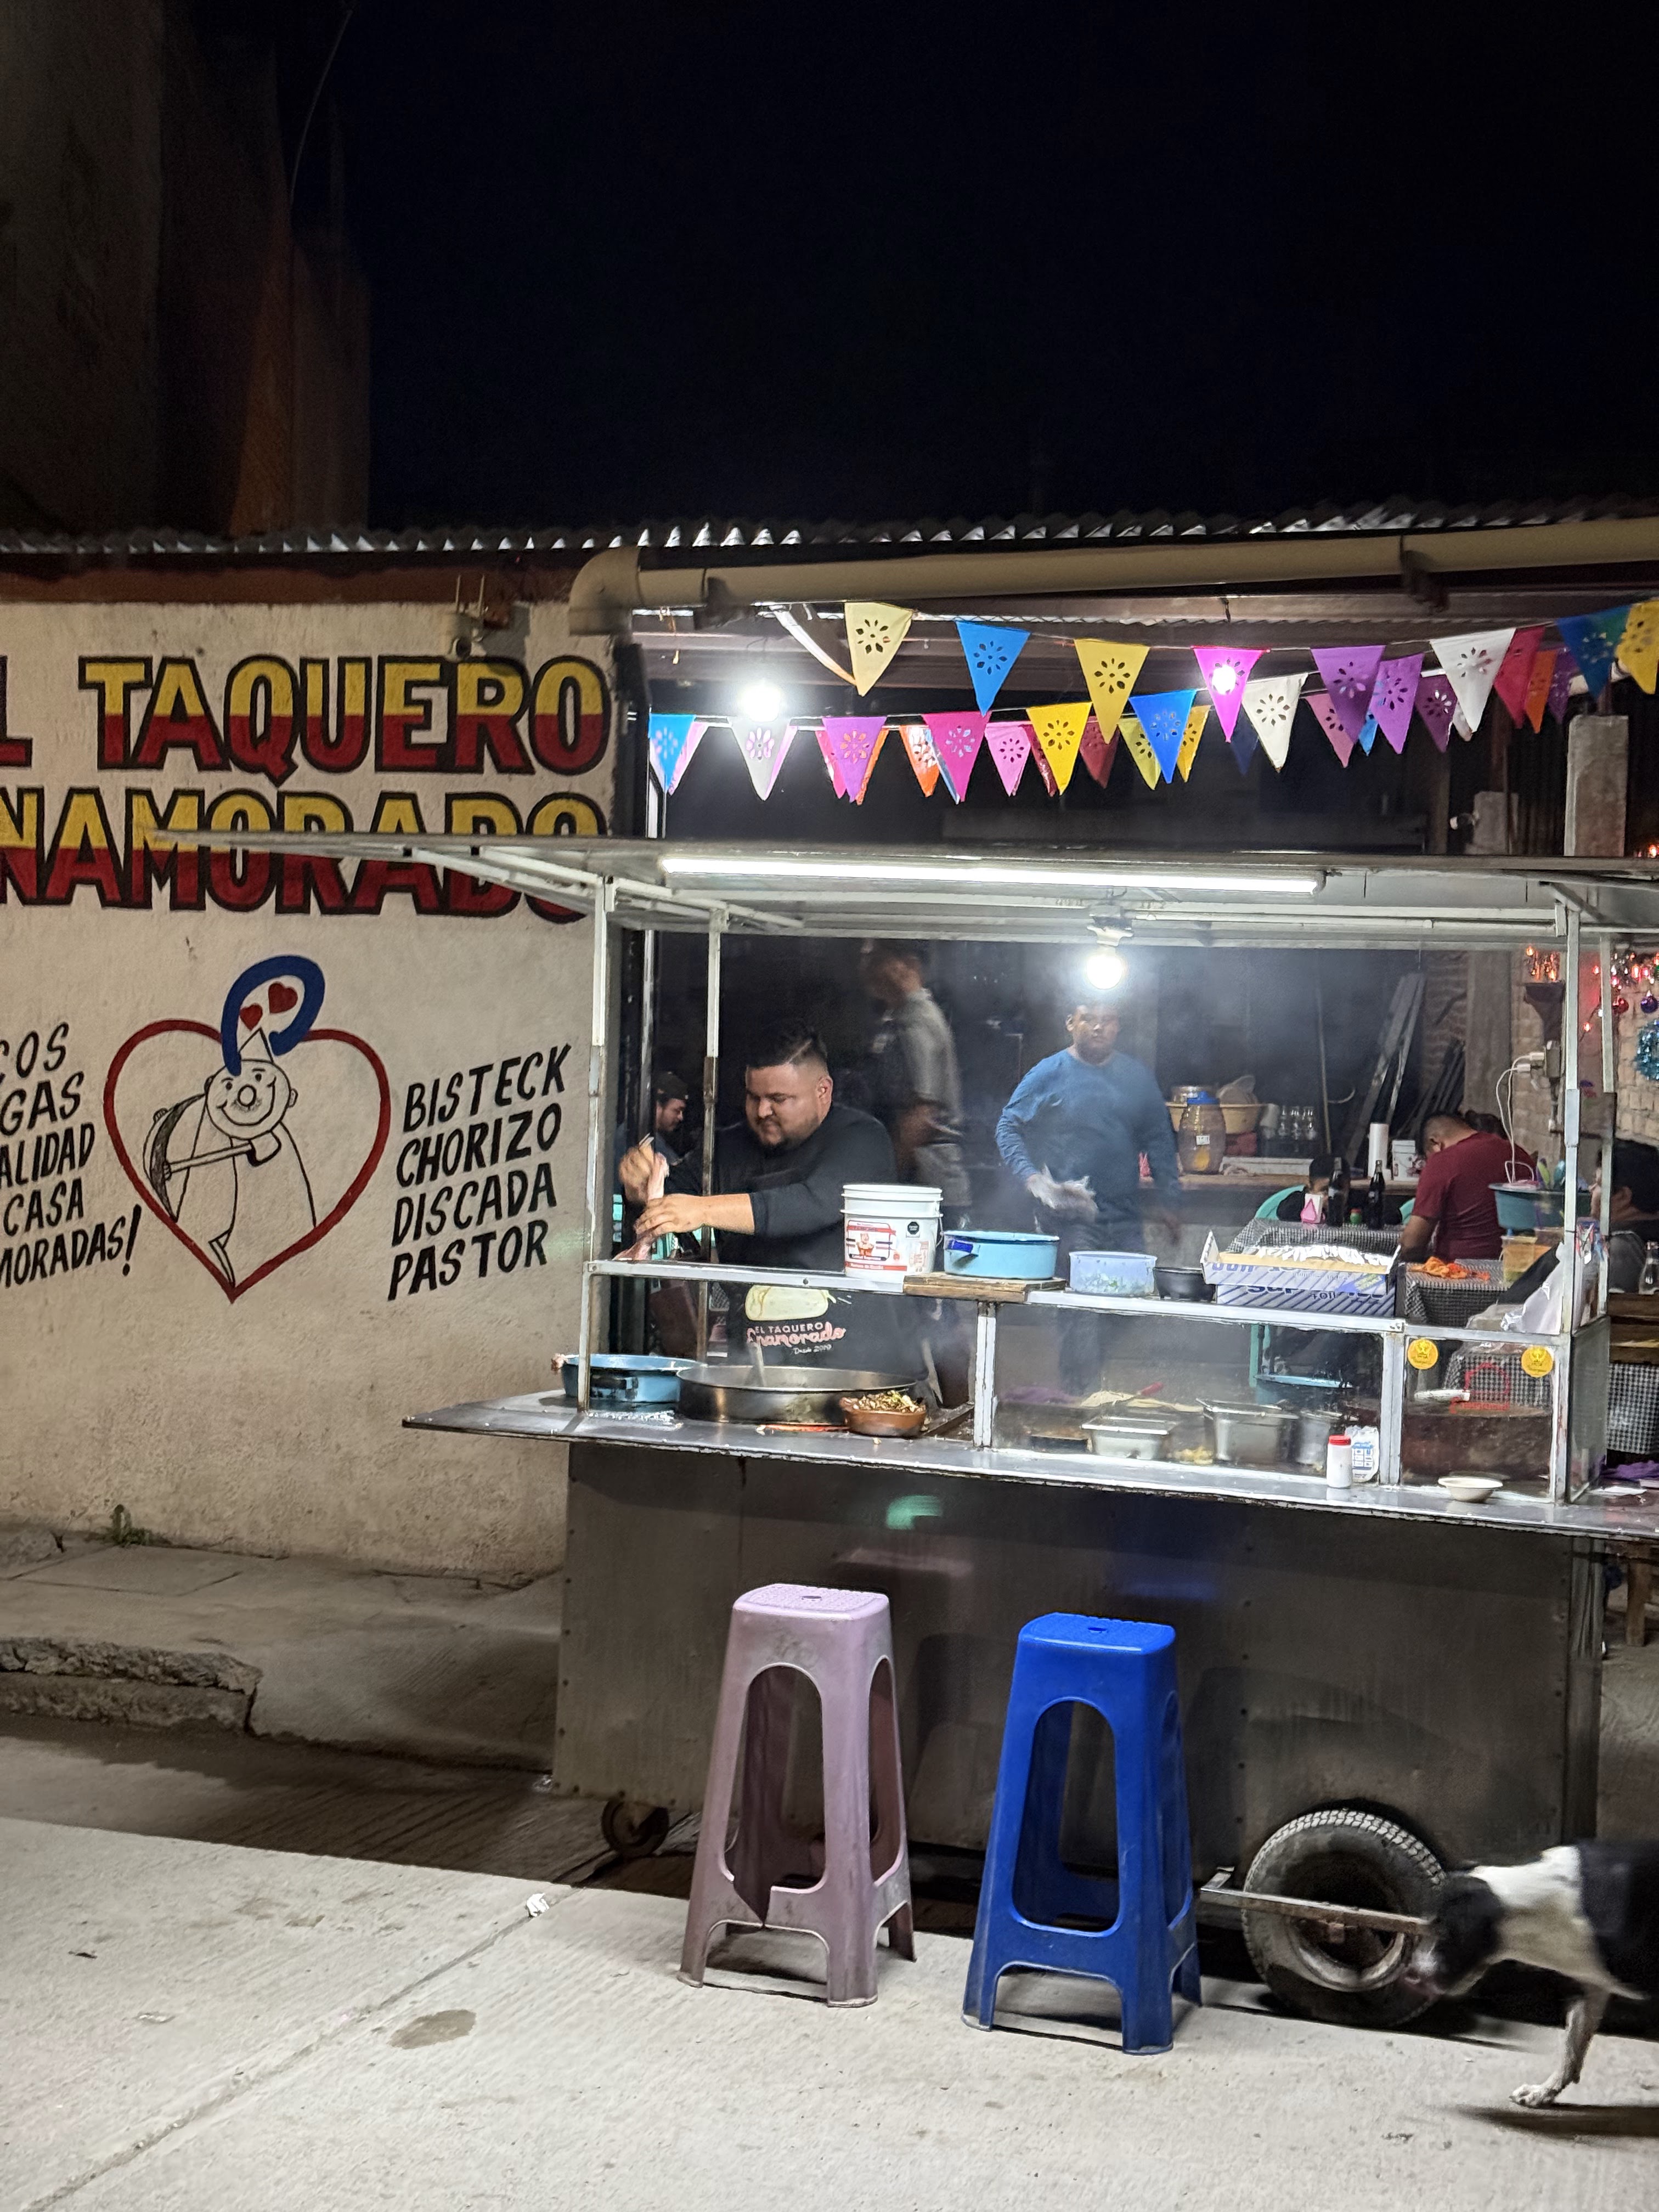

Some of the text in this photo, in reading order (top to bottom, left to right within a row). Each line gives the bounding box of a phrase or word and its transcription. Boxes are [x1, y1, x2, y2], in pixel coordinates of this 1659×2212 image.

[78, 655, 612, 787] TAQUERO
[0, 1071, 84, 1136] GAS
[403, 1042, 572, 1132] BISTECK
[396, 1103, 562, 1187] CHORIZO
[3, 1177, 83, 1236] CASA
[392, 1163, 557, 1247] DISCADA
[387, 1220, 549, 1301] PASTOR
[755, 1322, 823, 1334] EL TAQUERO
